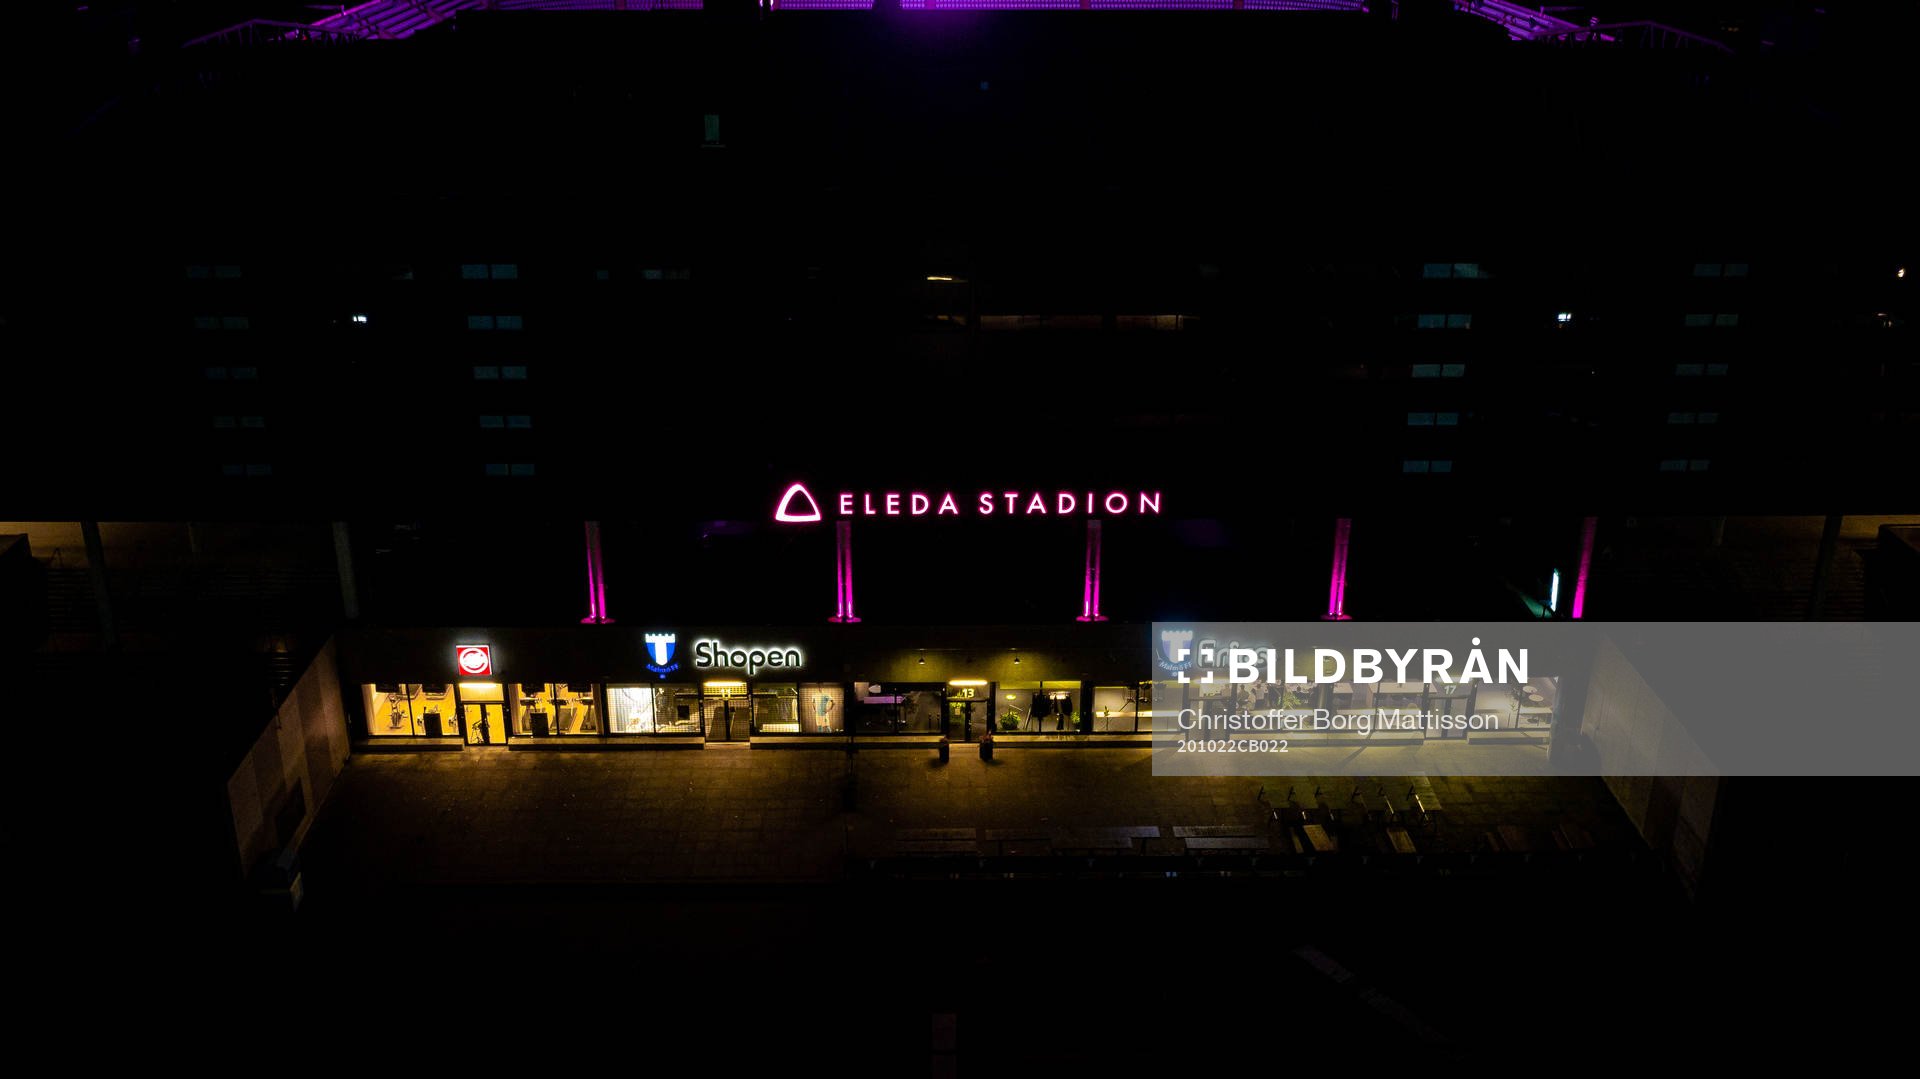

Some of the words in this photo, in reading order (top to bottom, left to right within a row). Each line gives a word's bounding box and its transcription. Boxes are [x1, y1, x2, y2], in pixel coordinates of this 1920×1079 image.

[839, 493, 958, 515] ELEDA
[978, 491, 1161, 515] STADION
[694, 638, 804, 675] Shopen
[962, 687, 975, 699] 13
[1444, 685, 1457, 695] 17
